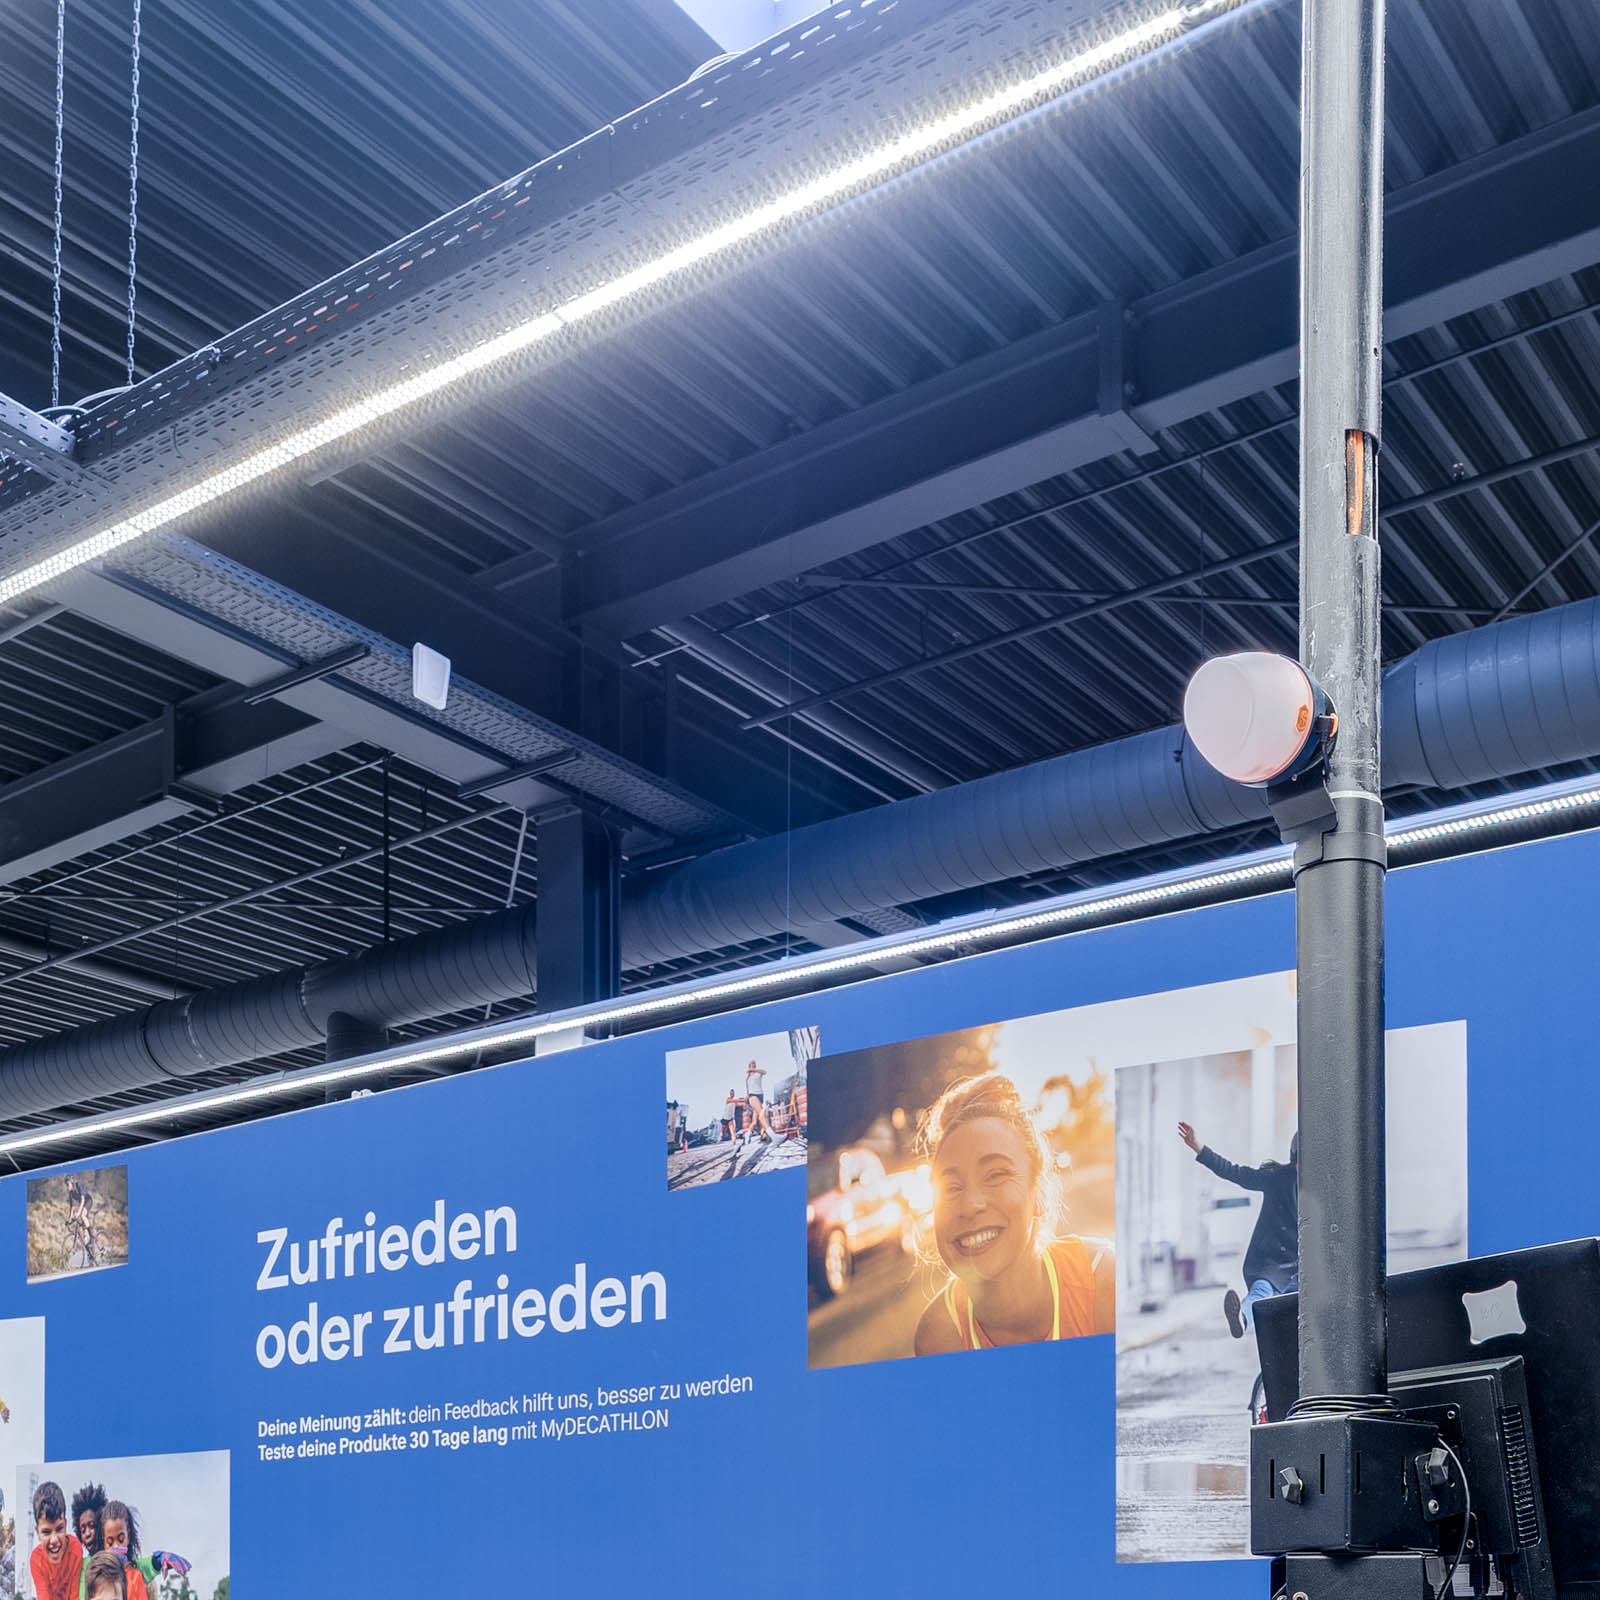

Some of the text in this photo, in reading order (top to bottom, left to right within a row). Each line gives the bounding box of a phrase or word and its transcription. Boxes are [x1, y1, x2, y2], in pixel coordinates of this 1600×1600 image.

[256, 1199, 517, 1291] Zufrieden
[255, 1262, 667, 1369] oder zufrieden
[257, 1373, 753, 1438] Deine Meinung zählt: dein Feedback hilft uns, besser zu werden
[257, 1408, 669, 1461] Teste deine Produkte 30 Tage lang mit MyDECATHLON
